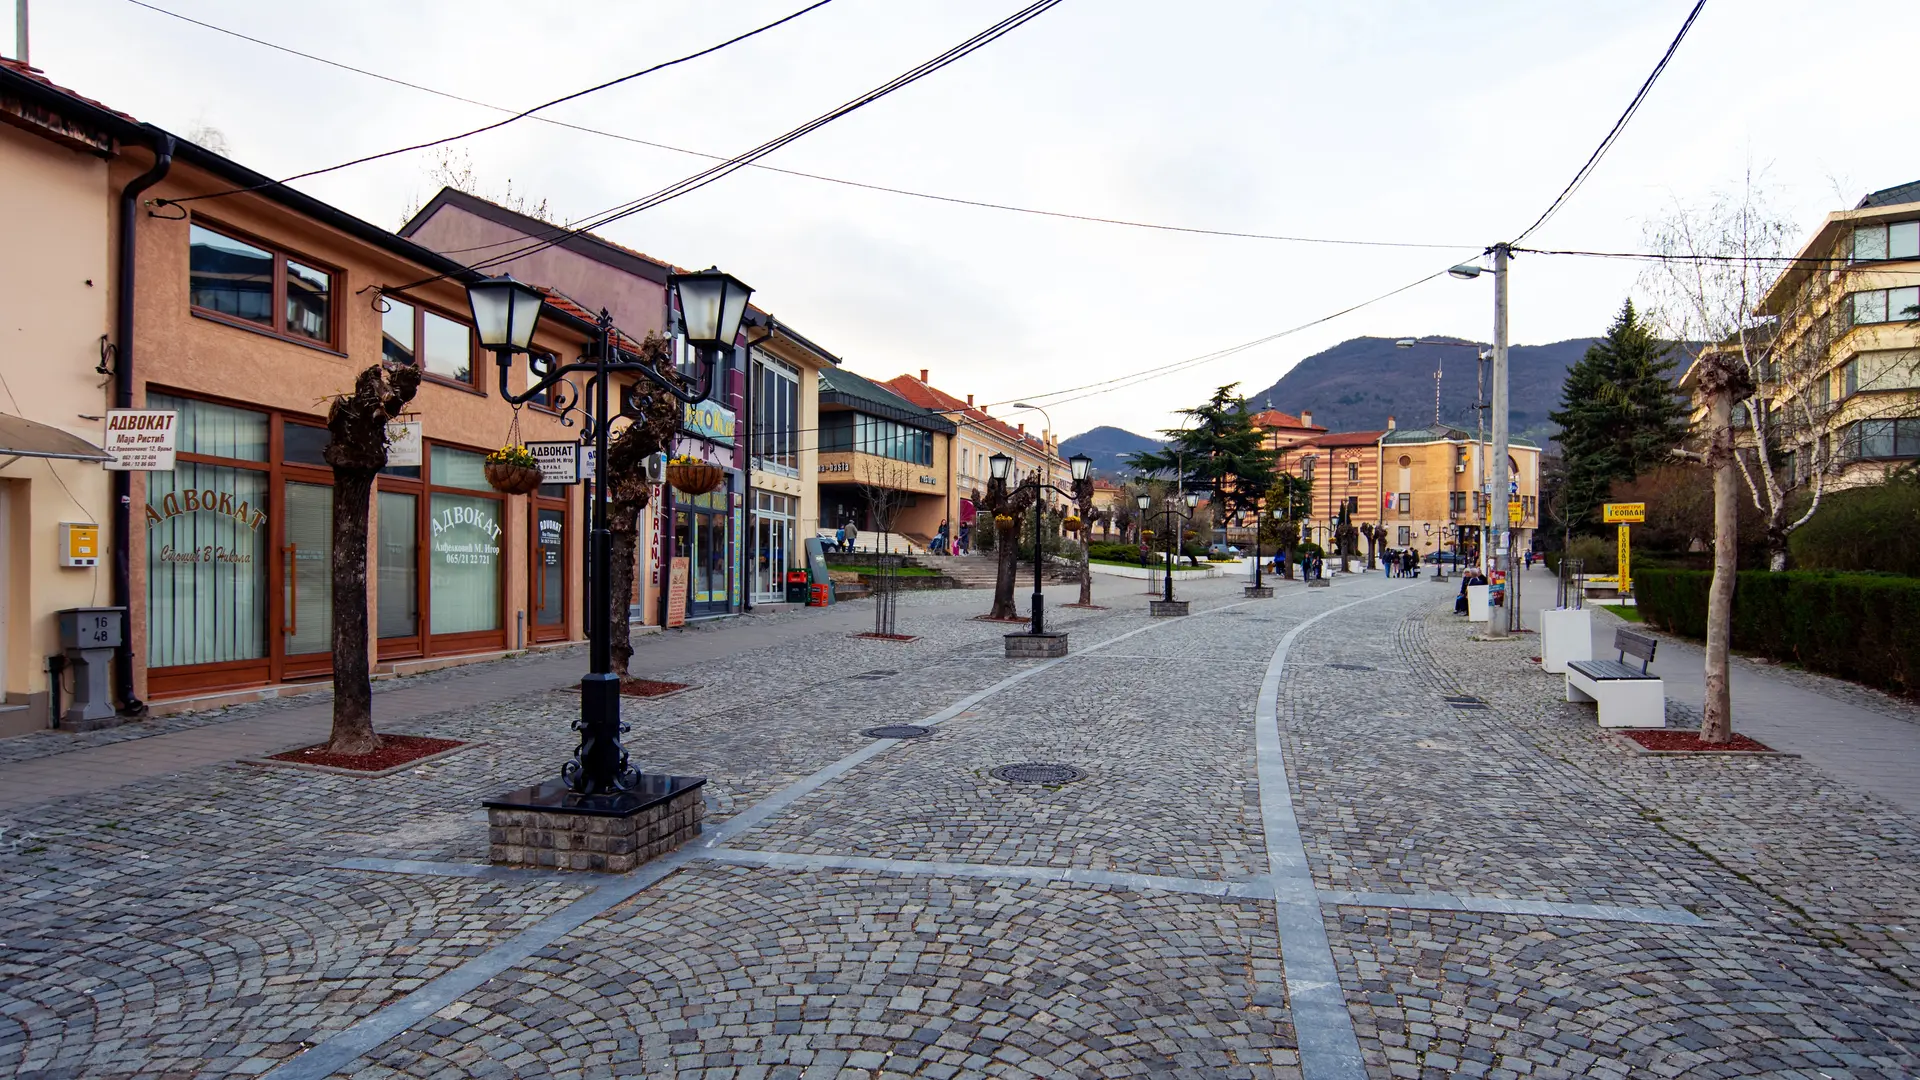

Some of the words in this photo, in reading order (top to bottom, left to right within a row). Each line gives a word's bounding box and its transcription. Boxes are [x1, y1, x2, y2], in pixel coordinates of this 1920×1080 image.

[108, 415, 174, 430] АДВОКАТ
[116, 434, 135, 444] Маја
[137, 434, 165, 443] Ристић
[531, 446, 573, 456] АДВОКАТ
[145, 489, 268, 532] АДВОКАТ
[432, 506, 502, 541] АДВОКАТ
[94, 617, 108, 628] 16
[93, 630, 108, 642] 48
